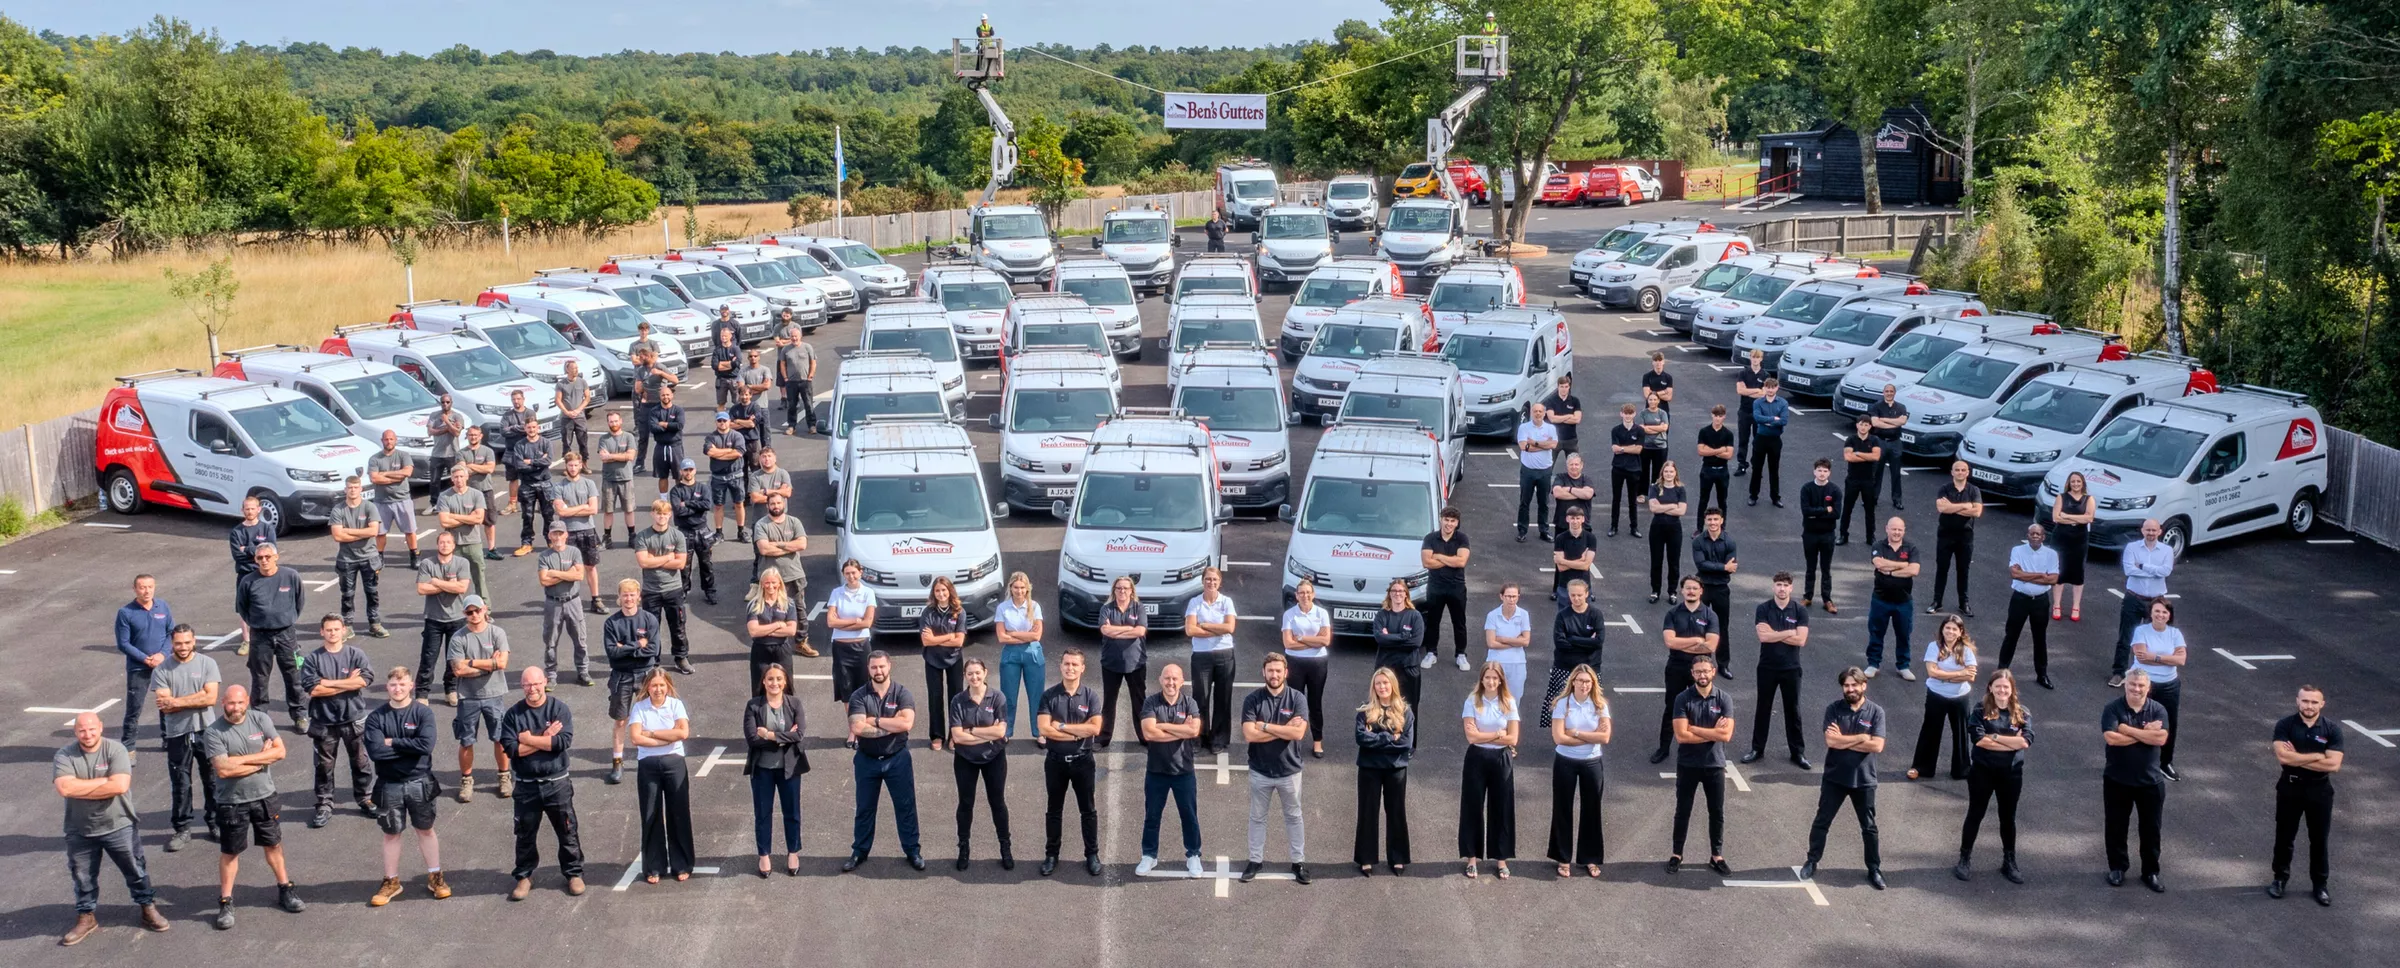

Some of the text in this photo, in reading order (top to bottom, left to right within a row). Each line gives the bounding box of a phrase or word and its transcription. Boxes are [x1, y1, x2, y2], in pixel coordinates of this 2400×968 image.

[1187, 101, 1264, 120] Ben's Gutters
[195, 461, 234, 474] bensgutters.com
[195, 468, 208, 477] 0800
[209, 471, 219, 479] 015
[1974, 470, 1988, 478] AJ24
[2205, 485, 2241, 498] bensgutters.com
[2205, 497, 2217, 506] 0800
[1129, 544, 1162, 552] Gutters
[1332, 549, 1388, 560] Ben's Gutters
[906, 607, 923, 616] AF7
[1144, 605, 1155, 613] EU
[1337, 610, 1359, 618] AJ24
